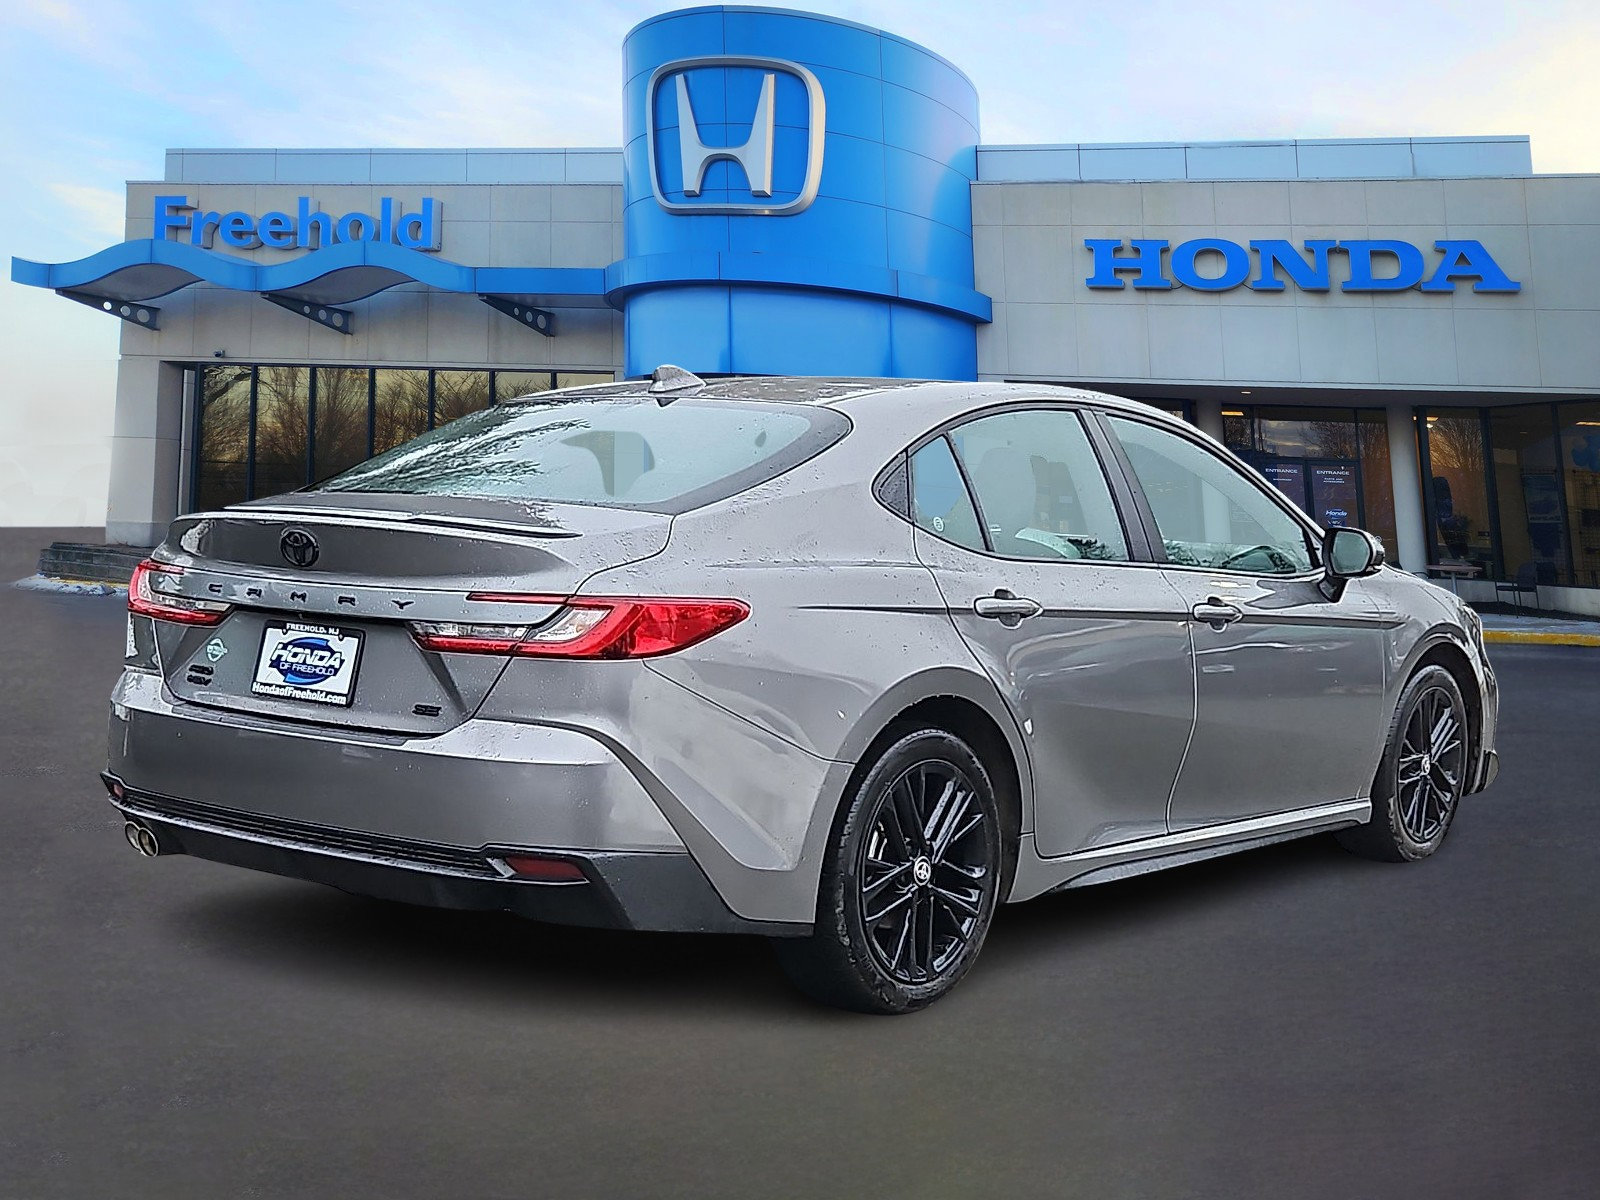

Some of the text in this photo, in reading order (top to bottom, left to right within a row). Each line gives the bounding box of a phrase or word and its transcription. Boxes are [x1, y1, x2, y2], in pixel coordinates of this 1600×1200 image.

[153, 195, 442, 251] Freehold
[1084, 238, 1521, 293] HONDA
[208, 583, 415, 611] CAMRY
[328, 627, 340, 635] NJ
[271, 643, 342, 669] HONDA
[279, 661, 335, 676] OF FREEHOLD
[251, 682, 347, 705] HondaofFreehold.com
